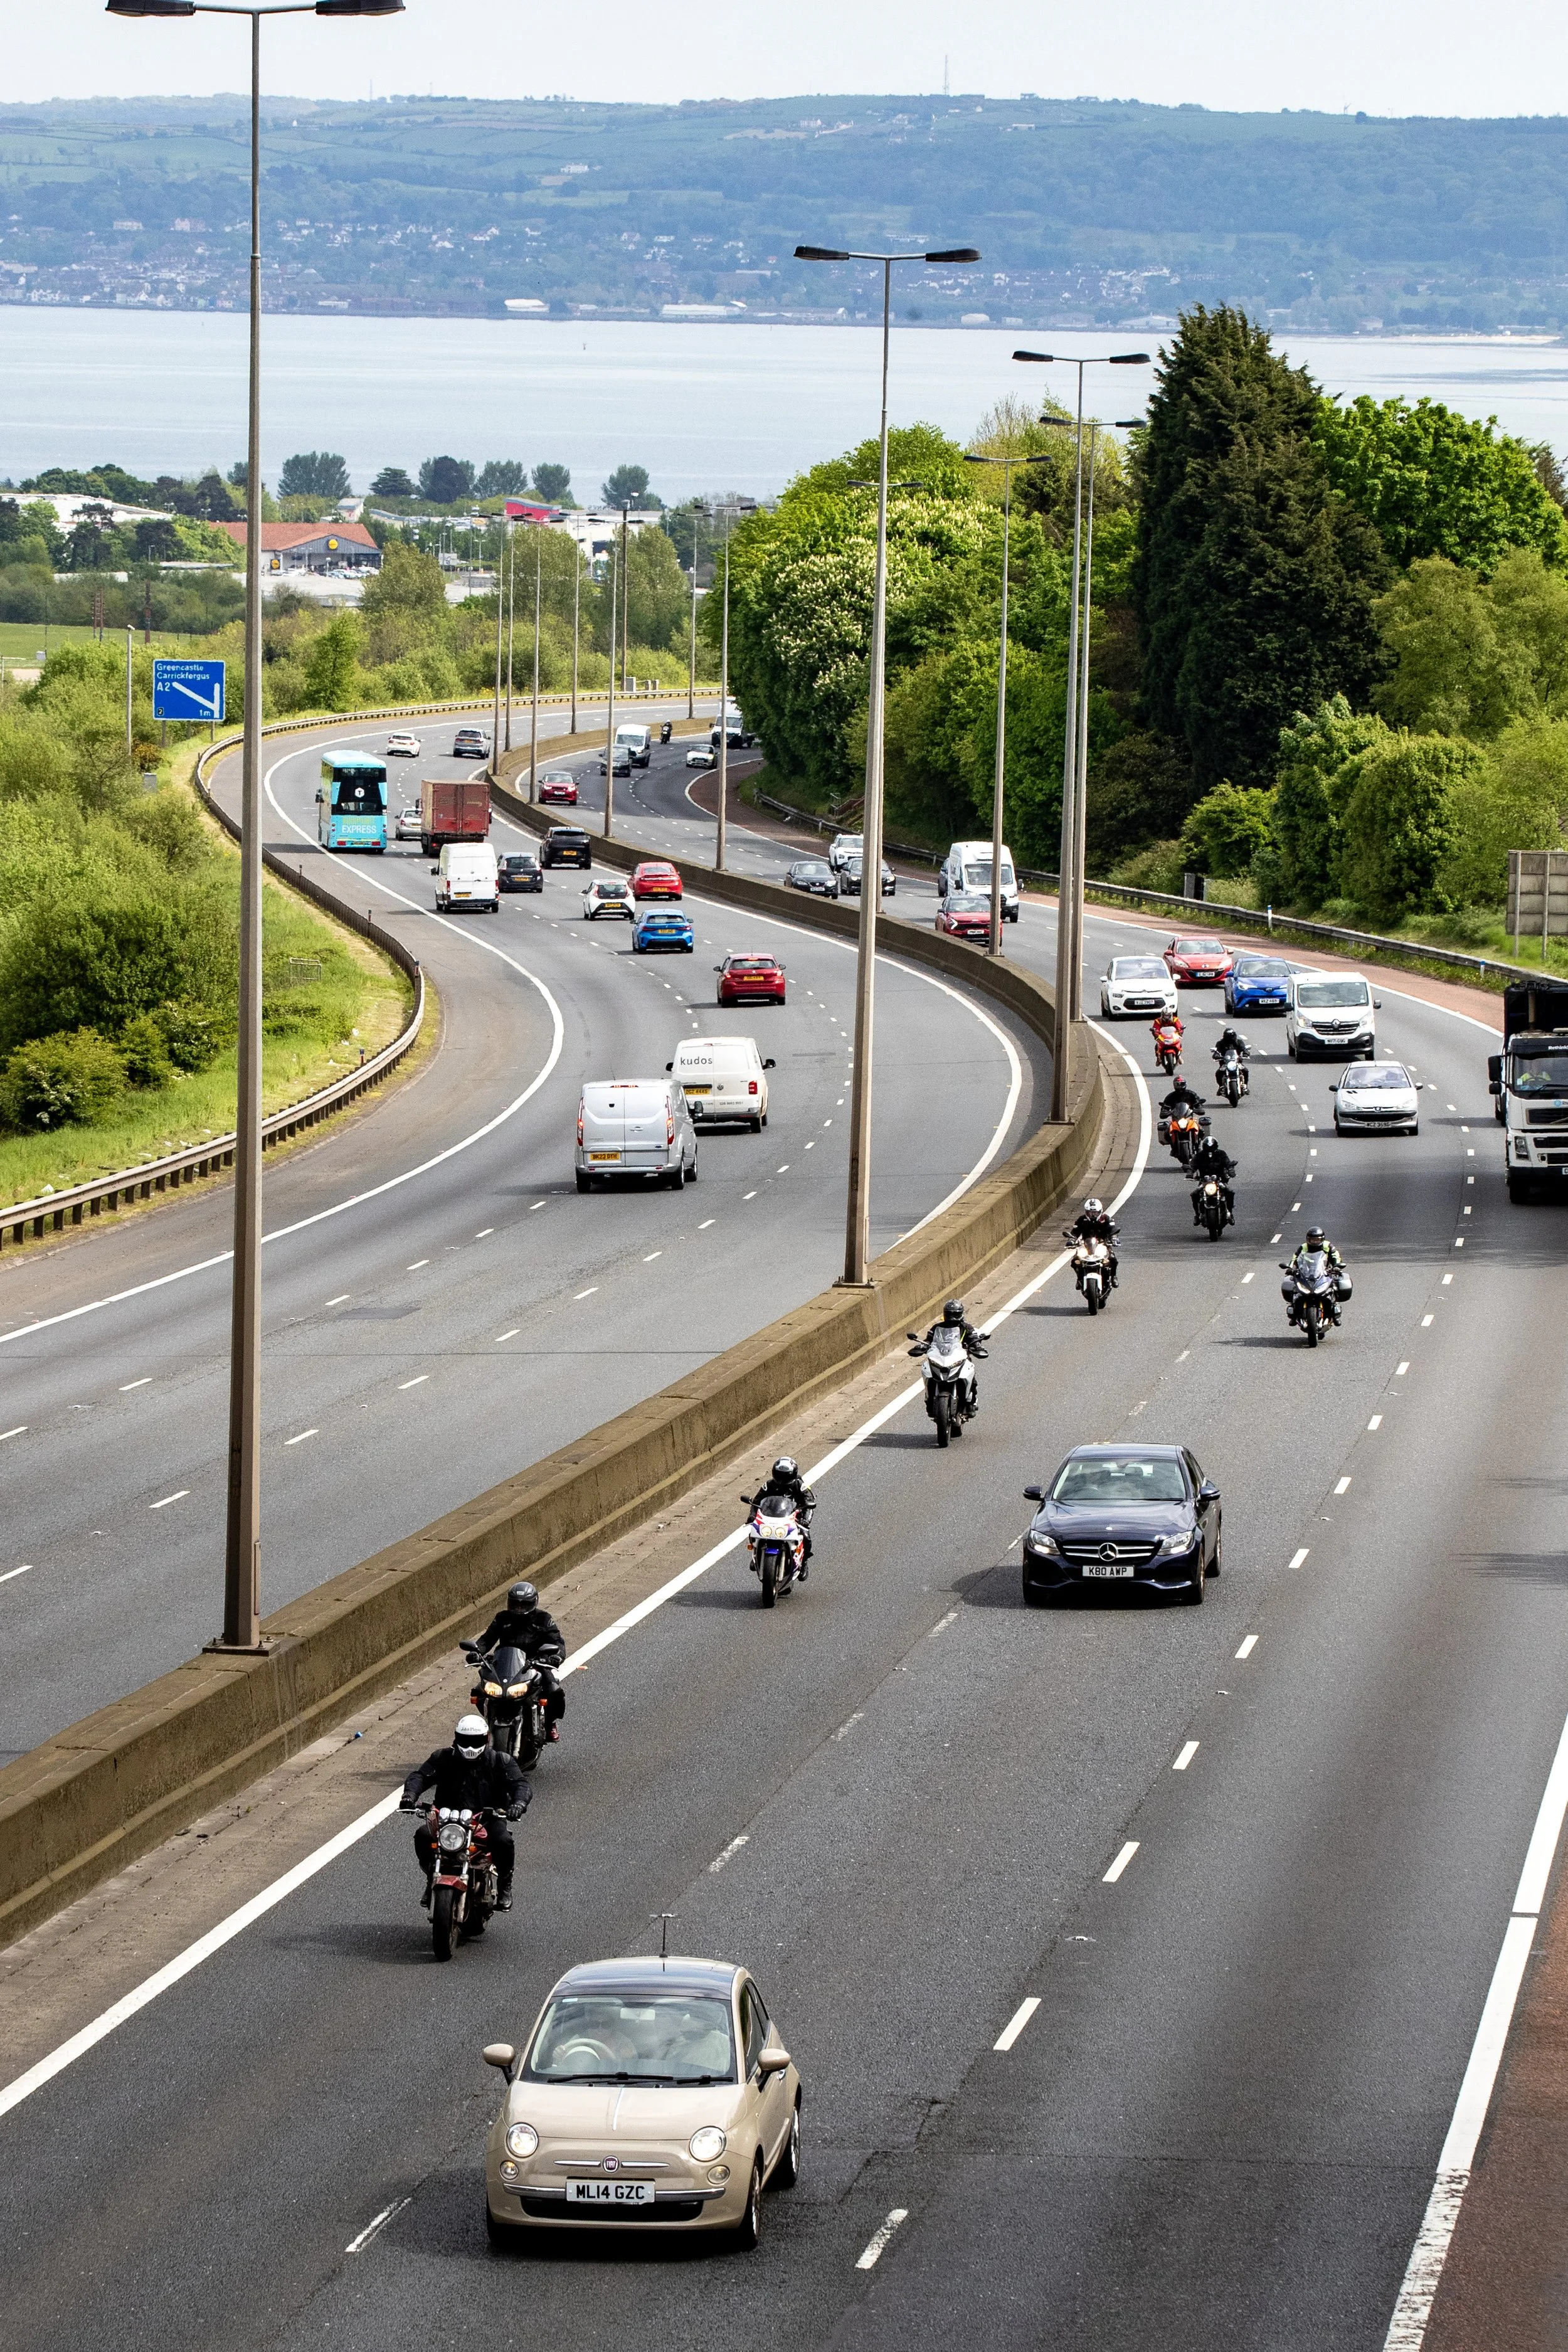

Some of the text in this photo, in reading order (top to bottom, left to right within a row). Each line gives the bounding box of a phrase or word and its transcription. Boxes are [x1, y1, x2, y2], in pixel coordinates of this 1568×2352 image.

[157, 682, 170, 691] A2
[342, 825, 376, 834] EXPRESS
[681, 1056, 712, 1066] kudos
[1110, 1567, 1127, 1576] AWP
[576, 2185, 645, 2200] ML14 GZC
